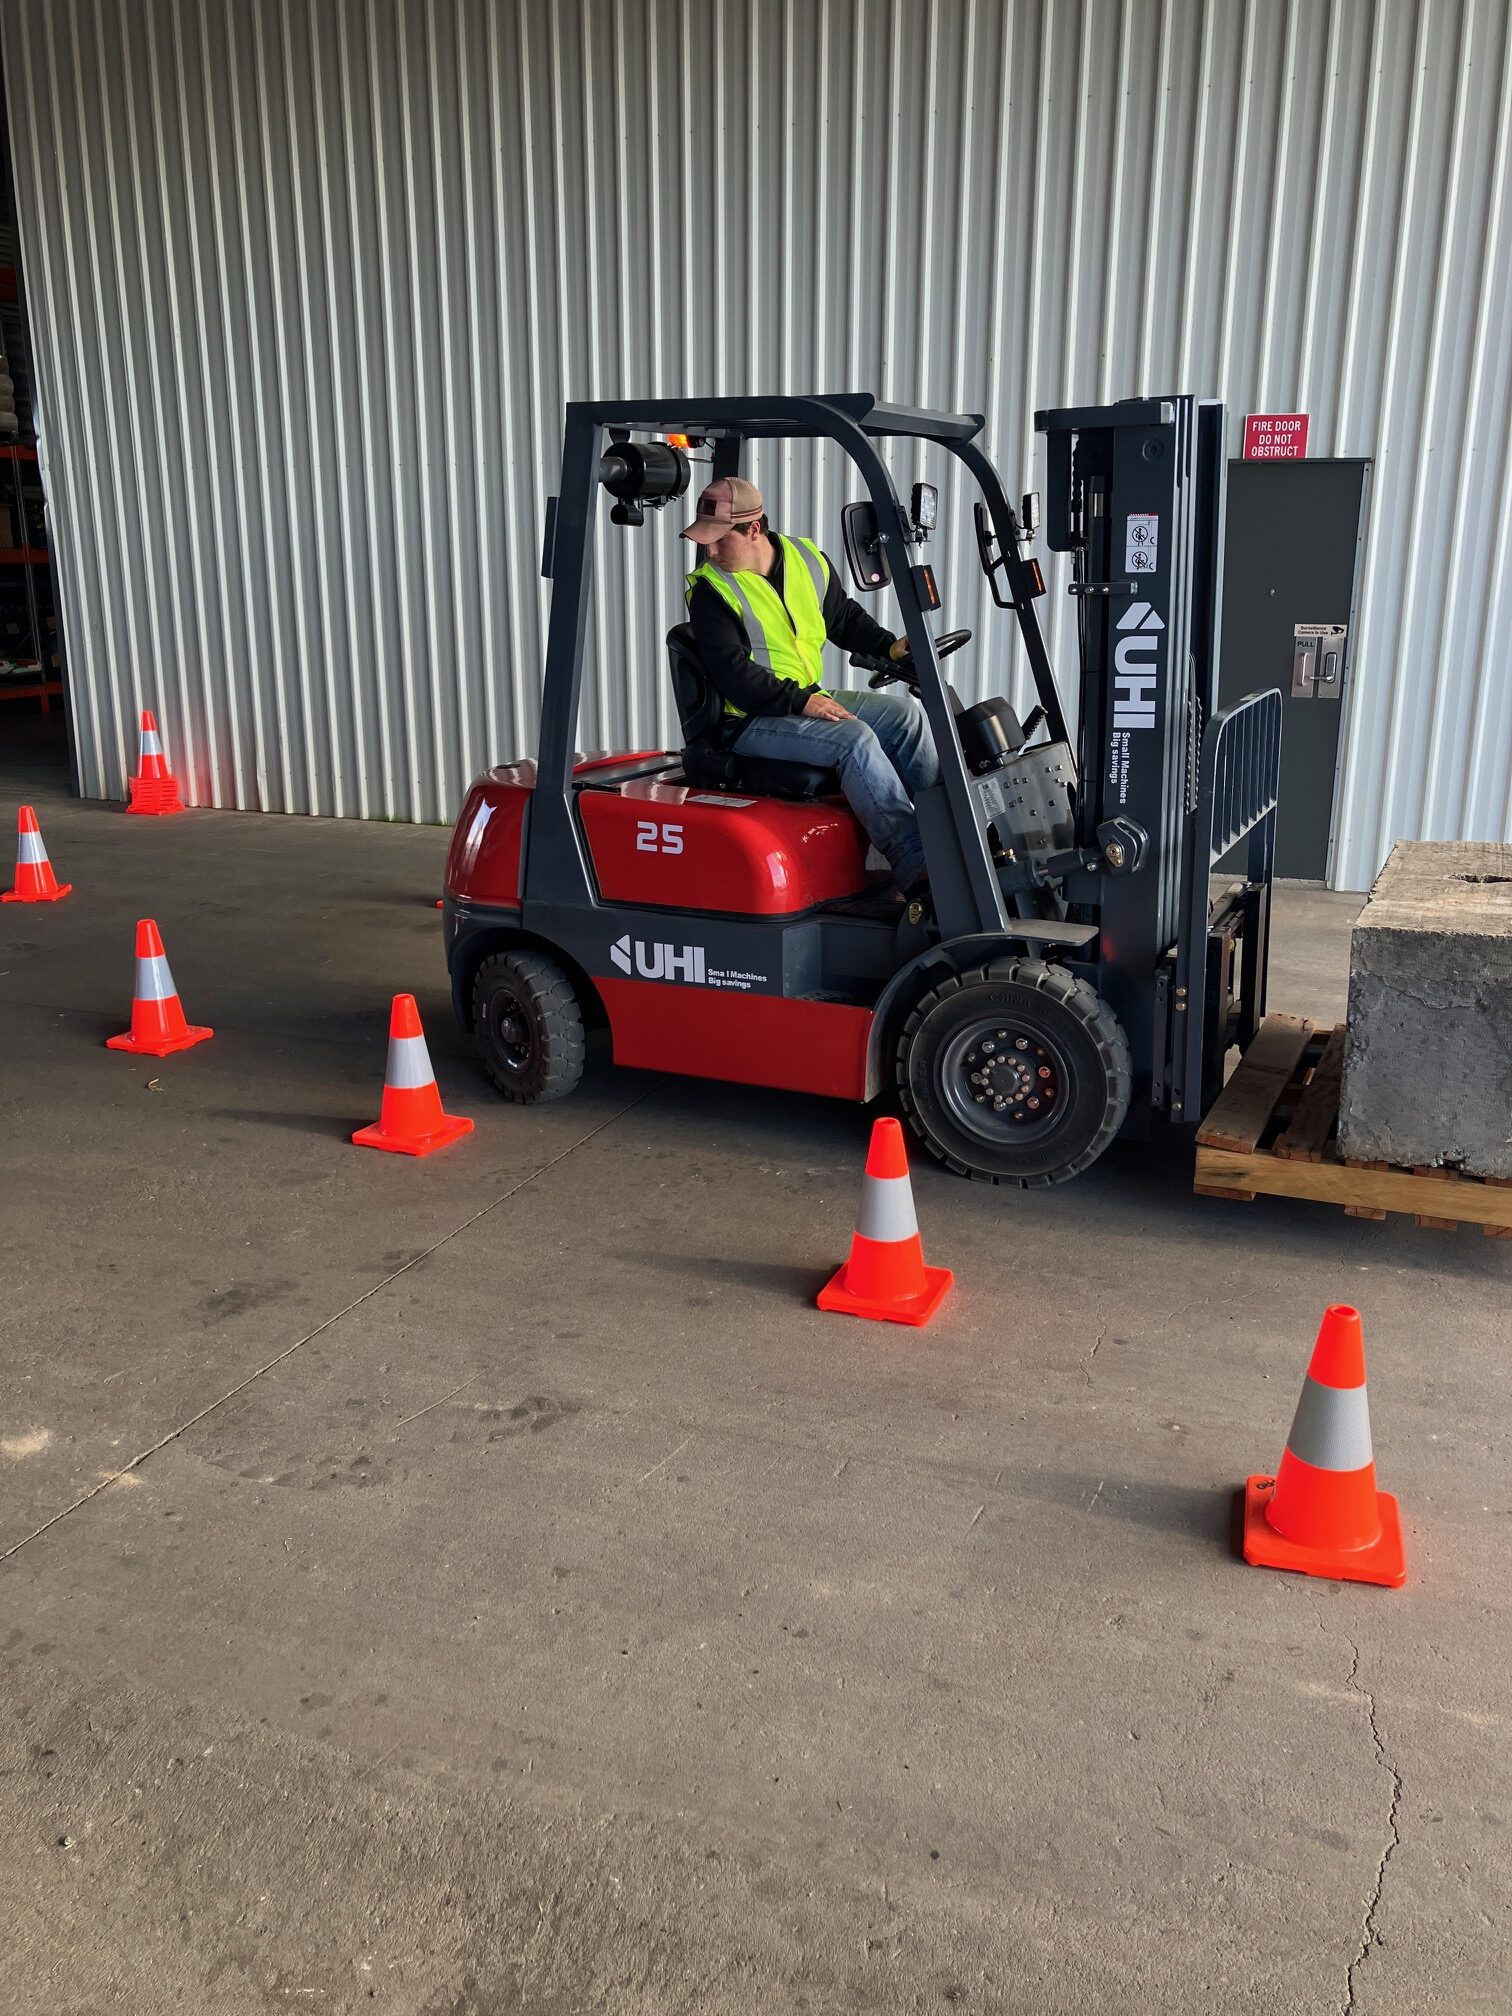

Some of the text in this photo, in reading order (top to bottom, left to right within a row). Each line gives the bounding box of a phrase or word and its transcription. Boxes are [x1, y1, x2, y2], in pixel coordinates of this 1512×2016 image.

[1252, 420, 1301, 431] FIRE DOOR
[1251, 445, 1299, 457] OBSTRUCT
[1259, 434, 1292, 444] DO NOT
[1114, 636, 1158, 728] UHI
[1109, 731, 1121, 784] Big savings
[1119, 732, 1131, 804] Small Machines
[636, 820, 684, 855] 25
[635, 940, 706, 984] UHI
[708, 968, 768, 983] Smal Machines
[708, 977, 752, 989] Big savings
